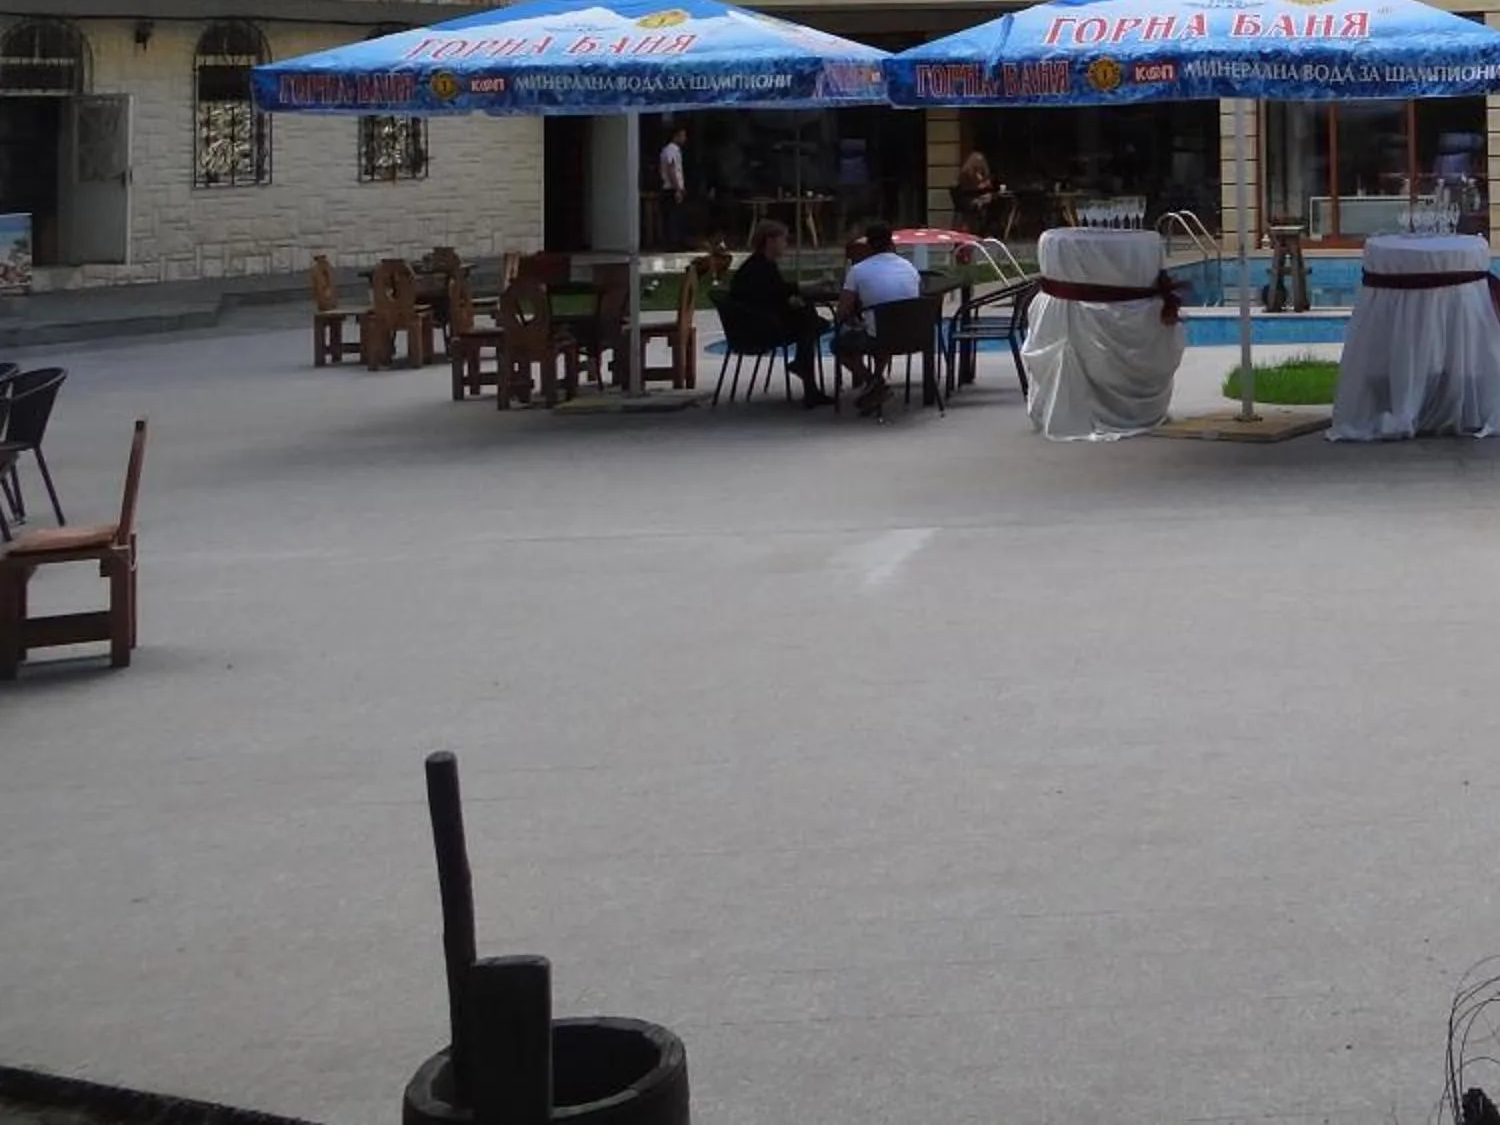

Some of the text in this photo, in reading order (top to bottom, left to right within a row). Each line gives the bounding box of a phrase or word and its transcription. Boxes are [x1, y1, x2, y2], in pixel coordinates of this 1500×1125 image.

[1043, 11, 1371, 46] ГОРНА БАНЯ
[406, 33, 698, 59] ГОРНА БАНЯ
[514, 73, 793, 92] МИНЕРАЛНА ВОДА ЗА ШАМПИОНИ
[1184, 60, 1300, 81] МИНЕРАЛНА
[1304, 64, 1351, 84] ВОДА
[1359, 65, 1382, 82] ЗА
